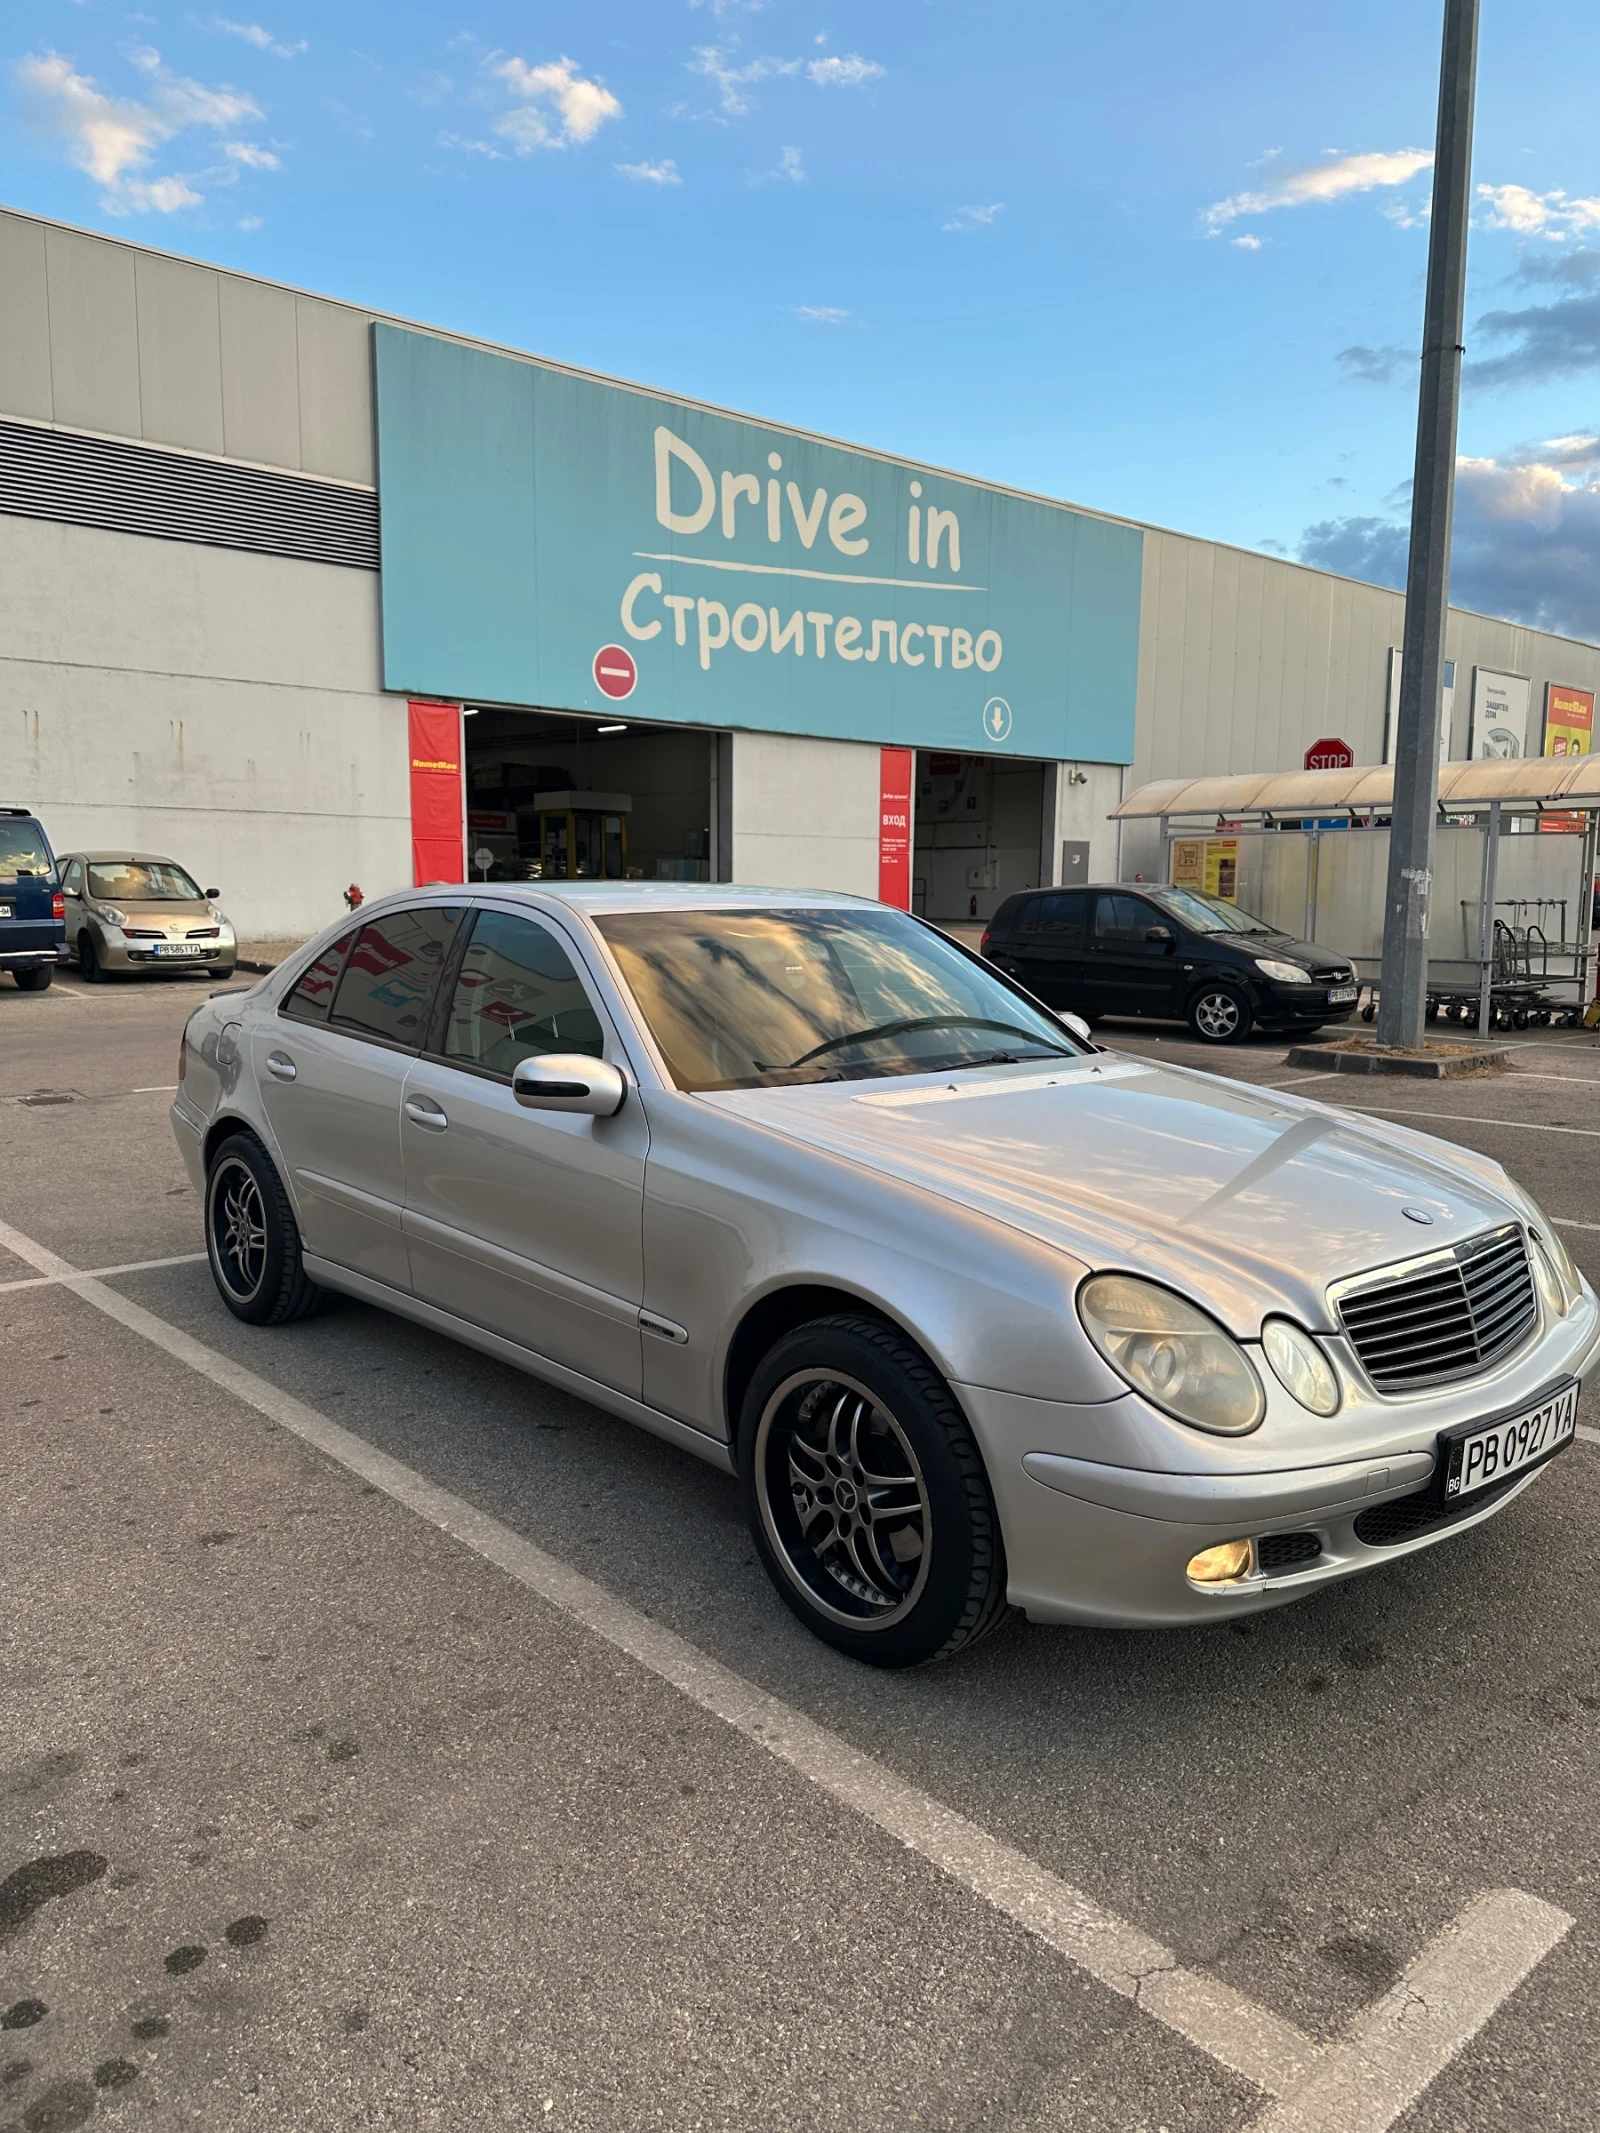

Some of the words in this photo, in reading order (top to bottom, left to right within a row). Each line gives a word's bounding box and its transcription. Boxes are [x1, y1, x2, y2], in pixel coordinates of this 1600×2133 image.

[654, 426, 869, 556] Drive
[908, 480, 961, 572] in
[620, 572, 1003, 672] Строителство
[1485, 700, 1509, 712] ЗАЩИТЕН
[1553, 697, 1588, 714] HomeMax
[1484, 709, 1497, 719] ДОМ
[412, 759, 457, 769] HomeMax
[1309, 753, 1348, 769] STOP
[882, 814, 906, 828] ВХОД
[1465, 1433, 1500, 1486] PB
[1502, 1404, 1553, 1468] 0927
[1553, 1392, 1573, 1439] YA
[1448, 1476, 1461, 1493] BG
